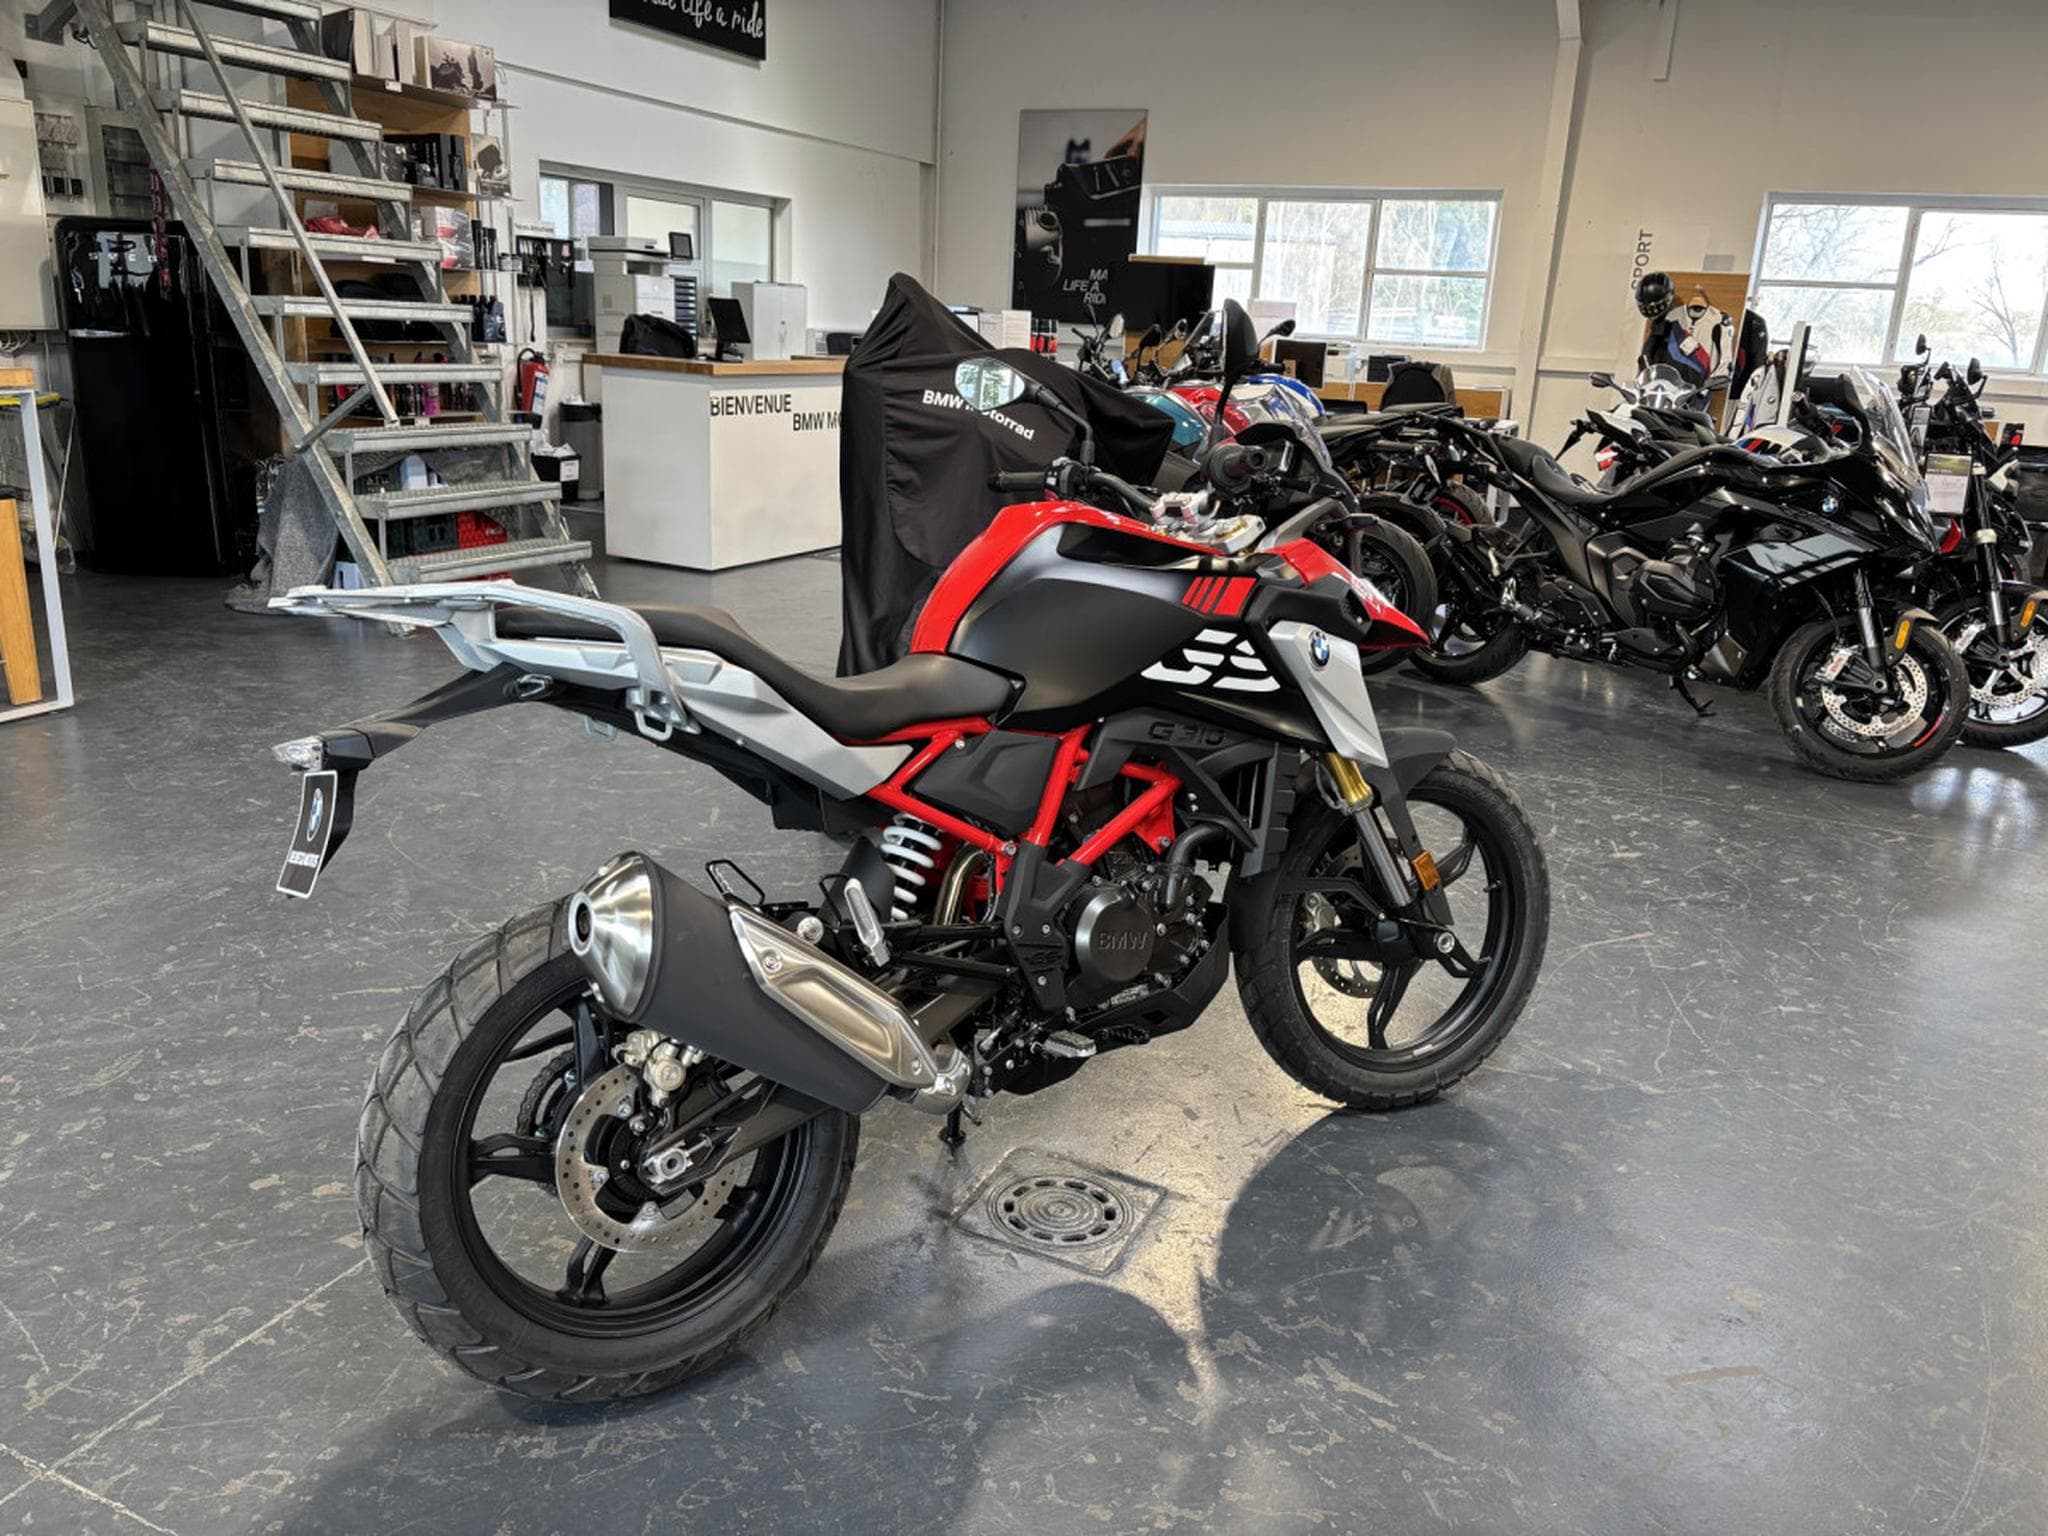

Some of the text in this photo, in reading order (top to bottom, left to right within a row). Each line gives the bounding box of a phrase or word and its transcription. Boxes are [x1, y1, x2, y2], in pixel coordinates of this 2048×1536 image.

[716, 7, 728, 27] a
[731, 1, 764, 38] ride
[1089, 268, 1108, 281] MA
[1063, 279, 1100, 292] LIFE A
[710, 394, 791, 416] BIENVENUE
[922, 389, 964, 409] BMW
[793, 410, 841, 431] BMW M
[1141, 628, 1281, 692] GS
[1099, 931, 1148, 950] BMW
